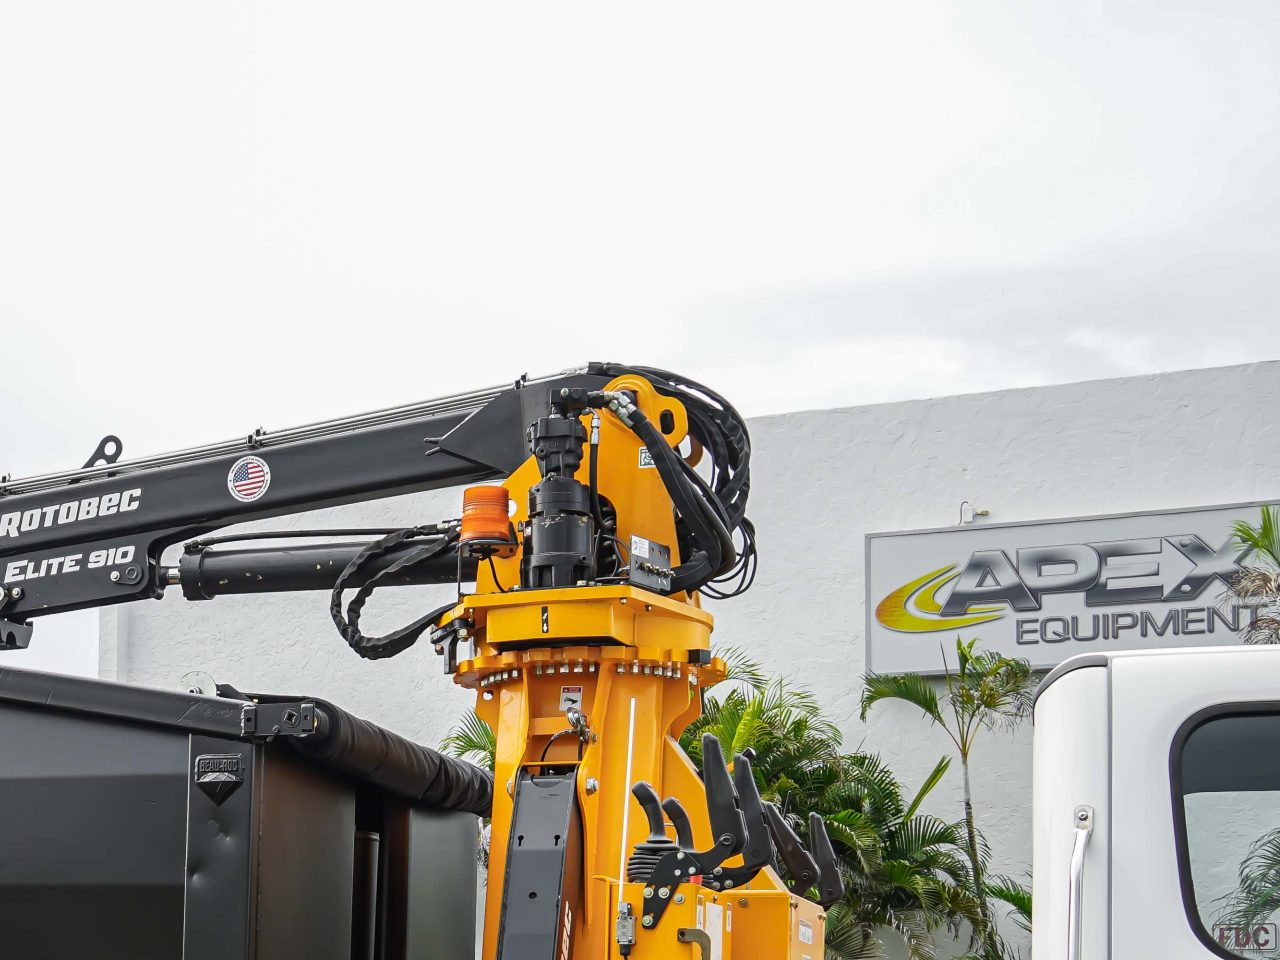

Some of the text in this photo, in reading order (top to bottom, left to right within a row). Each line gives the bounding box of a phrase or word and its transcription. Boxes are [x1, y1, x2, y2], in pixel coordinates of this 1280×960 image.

[4, 545, 135, 584] ELITE 910
[939, 533, 1256, 617] APEX
[1016, 603, 1267, 646] EQUIPMENT
